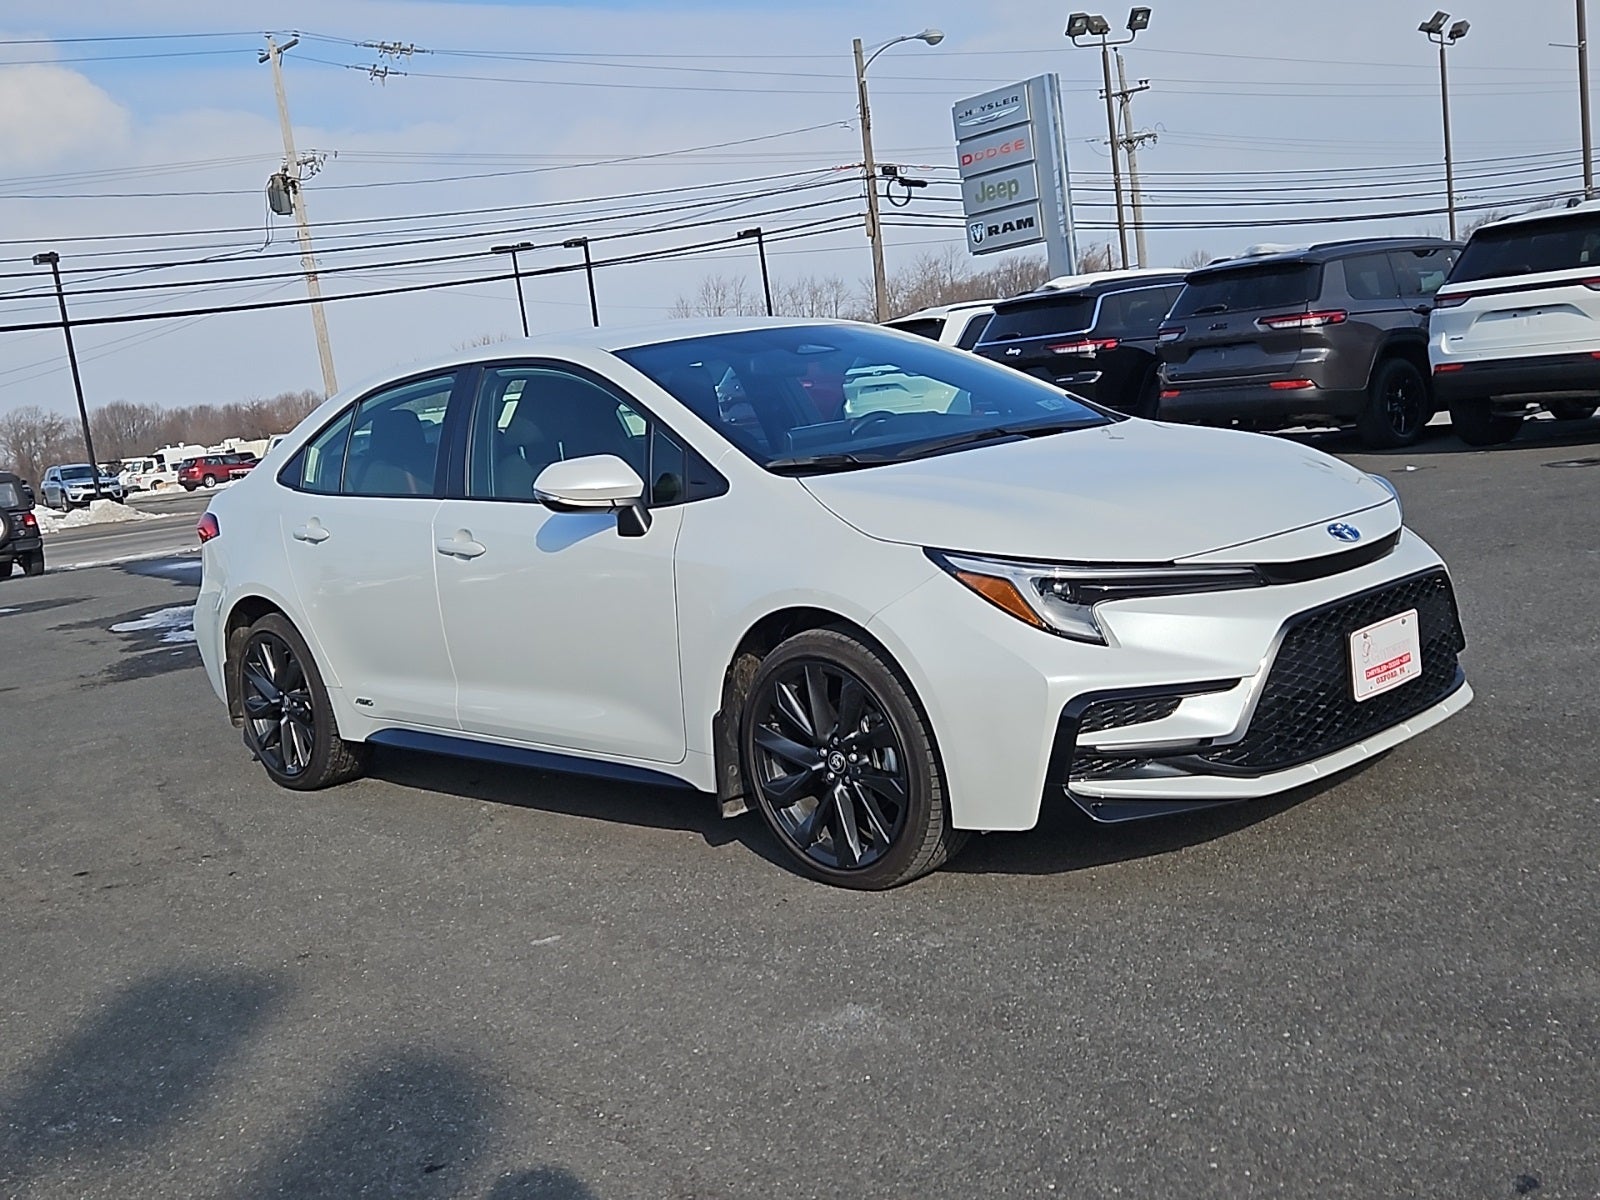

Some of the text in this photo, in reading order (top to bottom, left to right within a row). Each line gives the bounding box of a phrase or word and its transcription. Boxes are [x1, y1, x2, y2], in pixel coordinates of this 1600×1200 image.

[961, 139, 1026, 166] DODGE
[974, 178, 1020, 204] Jeep
[987, 216, 1035, 237] RAM
